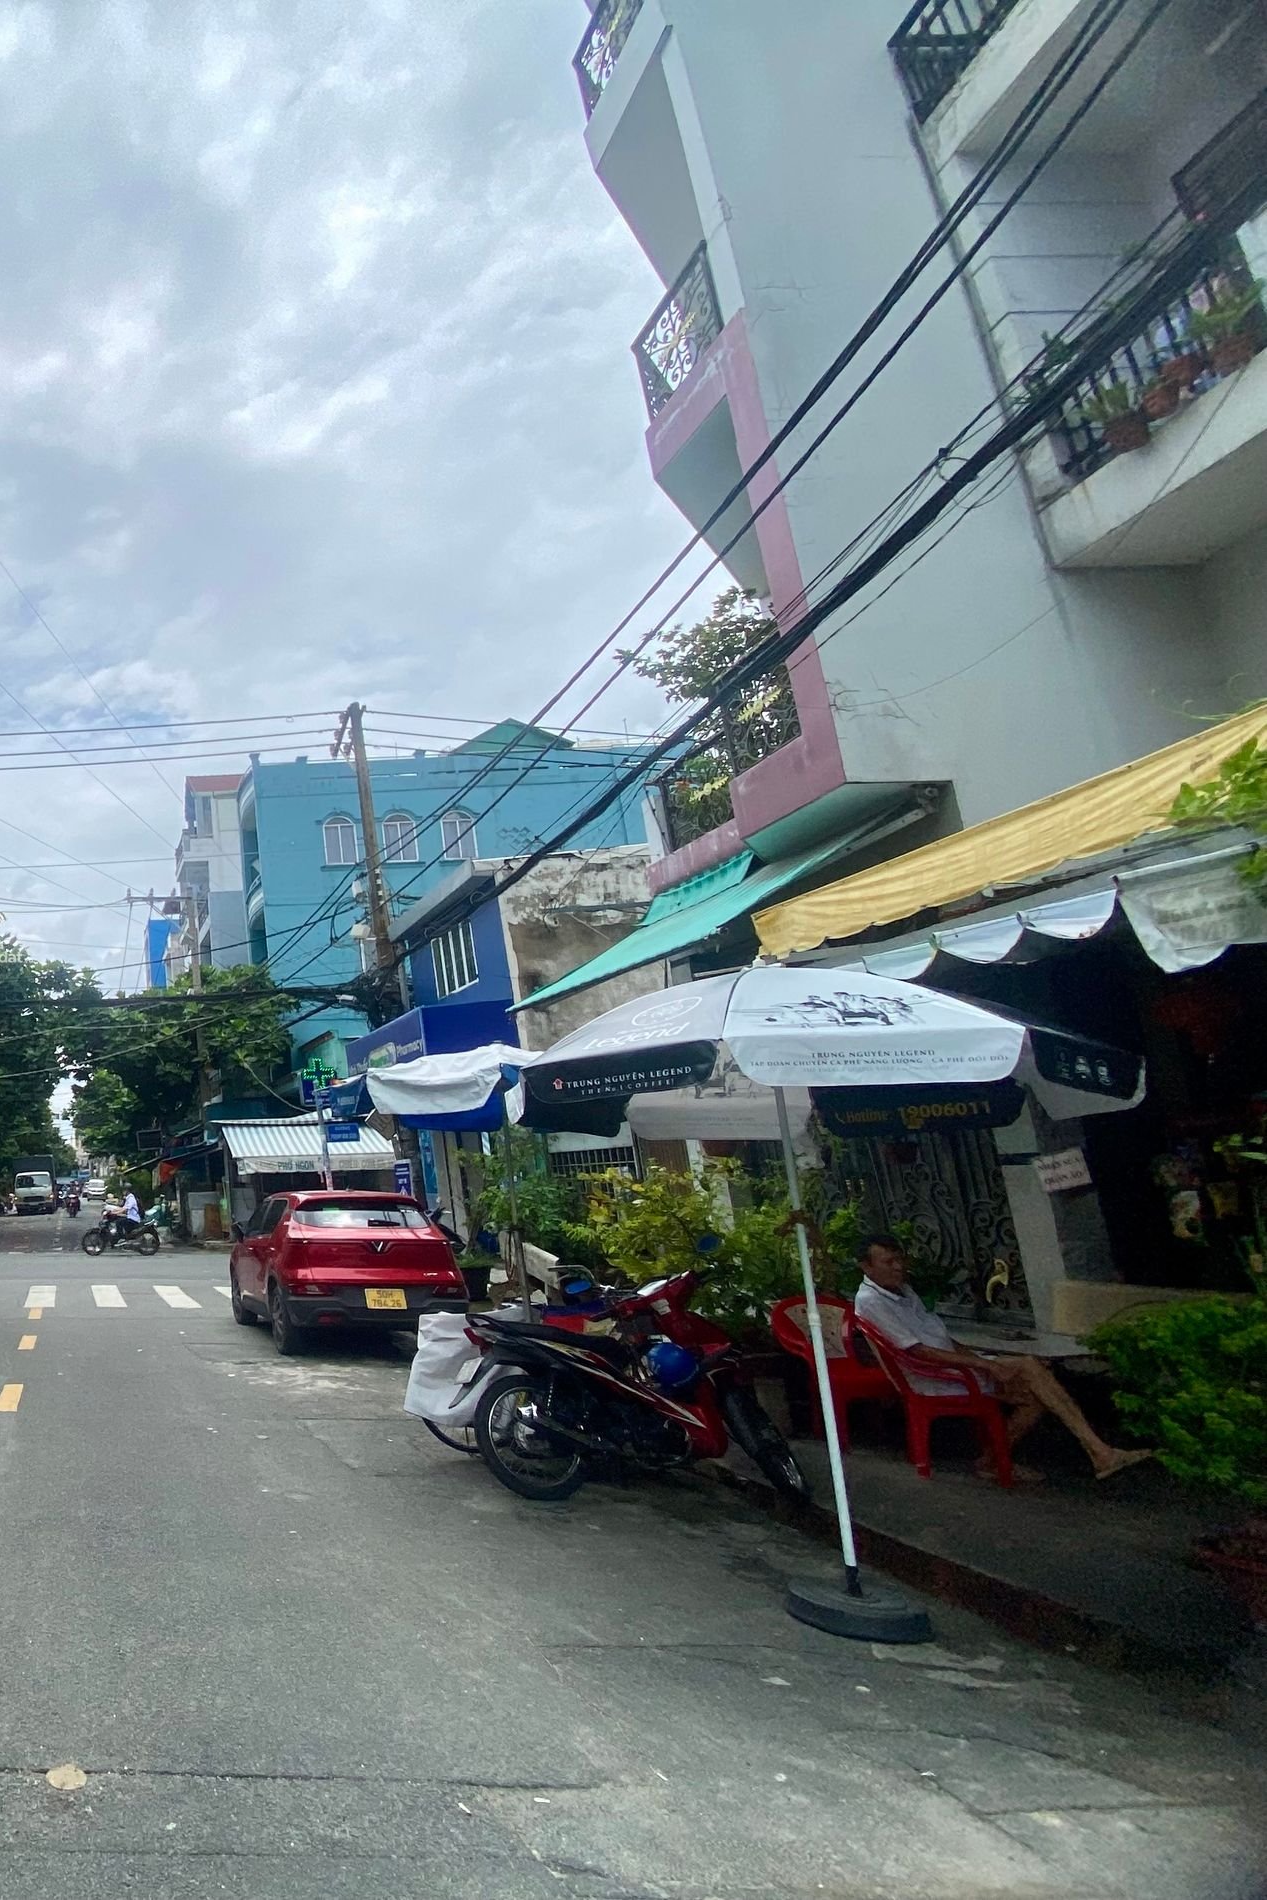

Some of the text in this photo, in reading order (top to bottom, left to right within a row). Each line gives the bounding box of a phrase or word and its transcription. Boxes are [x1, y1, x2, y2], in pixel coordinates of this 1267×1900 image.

[812, 1051, 845, 1059] TRUNG
[894, 1048, 935, 1057] LEGEND
[566, 1065, 692, 1089] TRUNG NGUYÊN LEGEND
